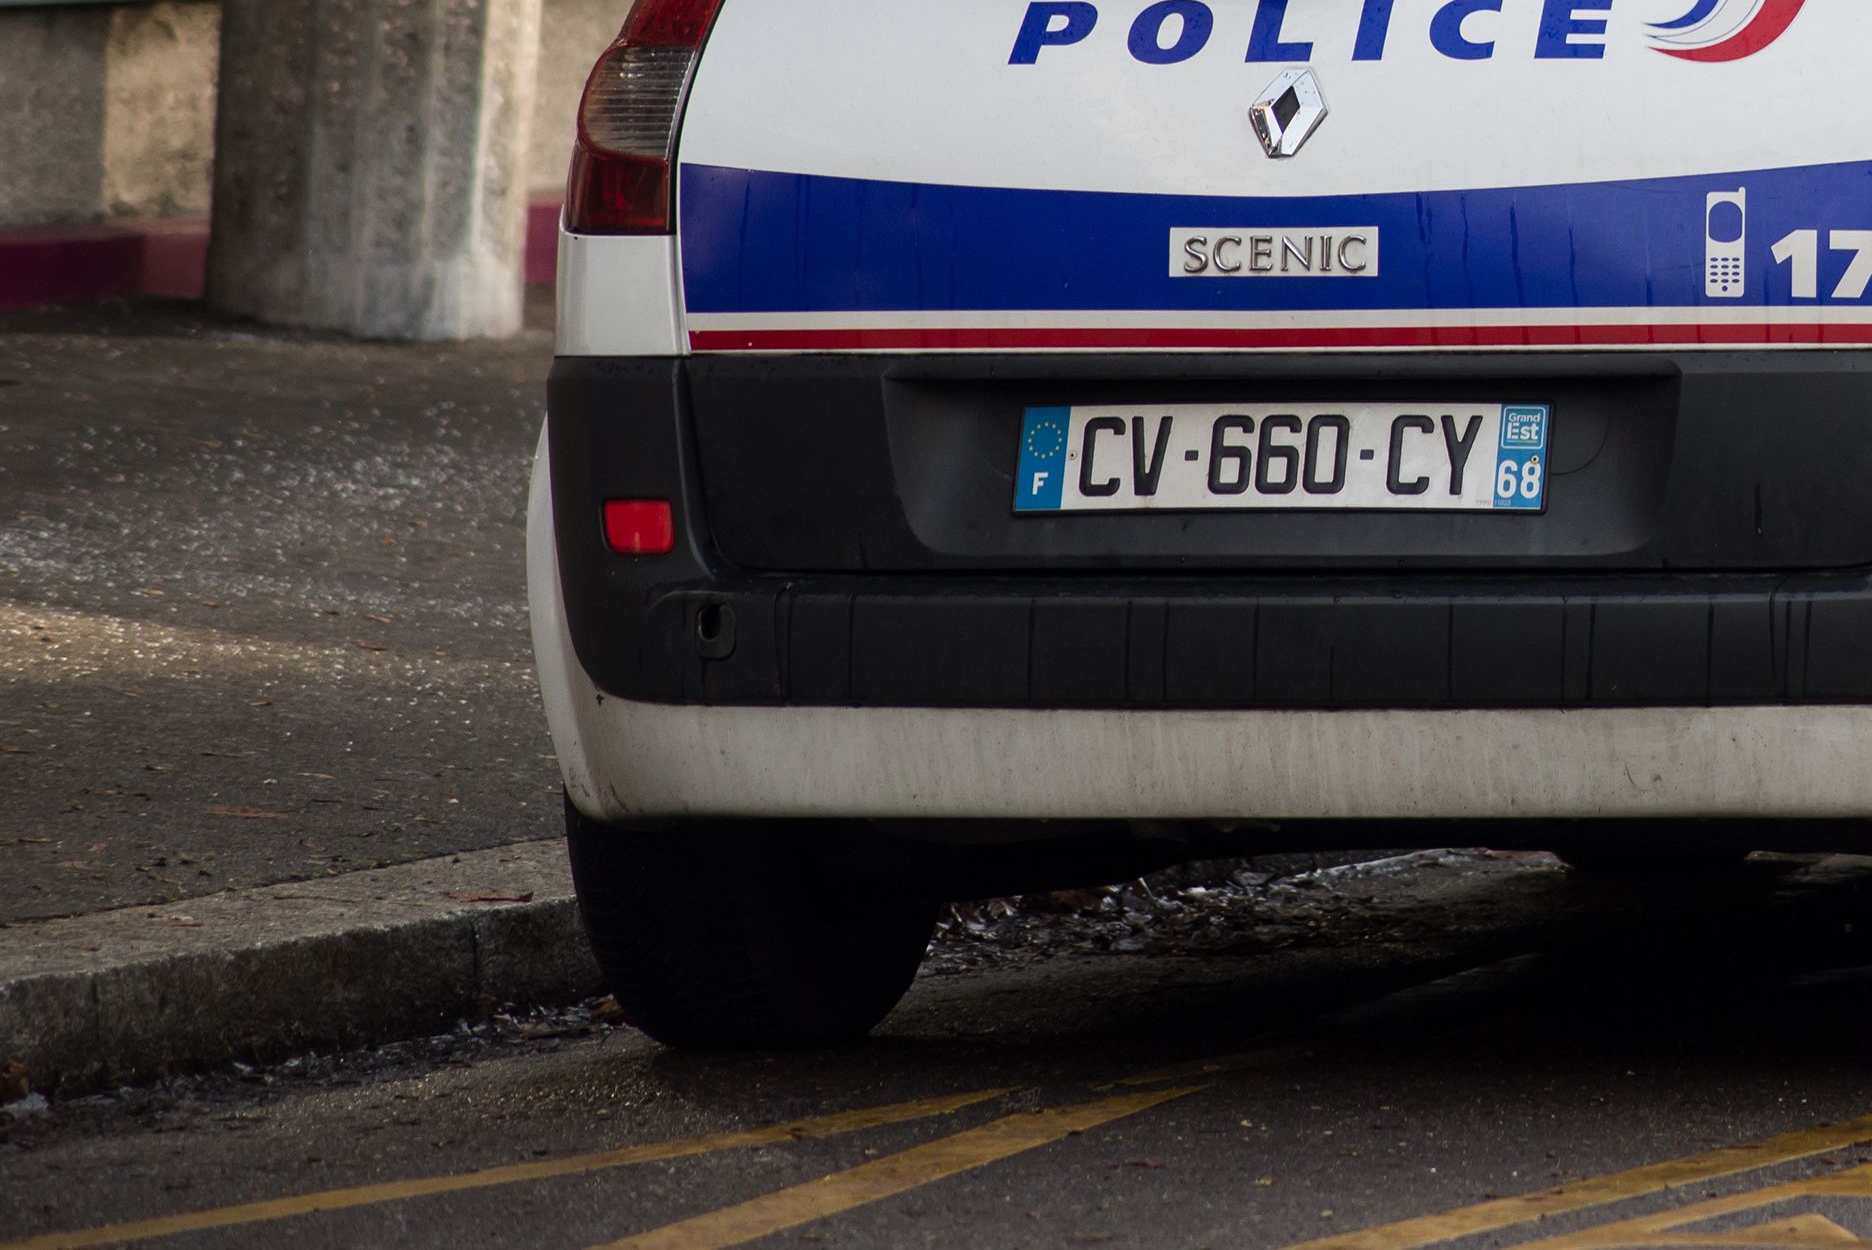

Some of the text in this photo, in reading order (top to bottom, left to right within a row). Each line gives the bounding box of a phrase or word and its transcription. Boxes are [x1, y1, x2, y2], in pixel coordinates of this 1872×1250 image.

[1183, 234, 1368, 274] SCENIC
[1506, 421, 1540, 440] Est
[1508, 412, 1541, 423] Grand
[1031, 413, 1484, 497] F CV-660-CY
[1497, 459, 1542, 499] 68
